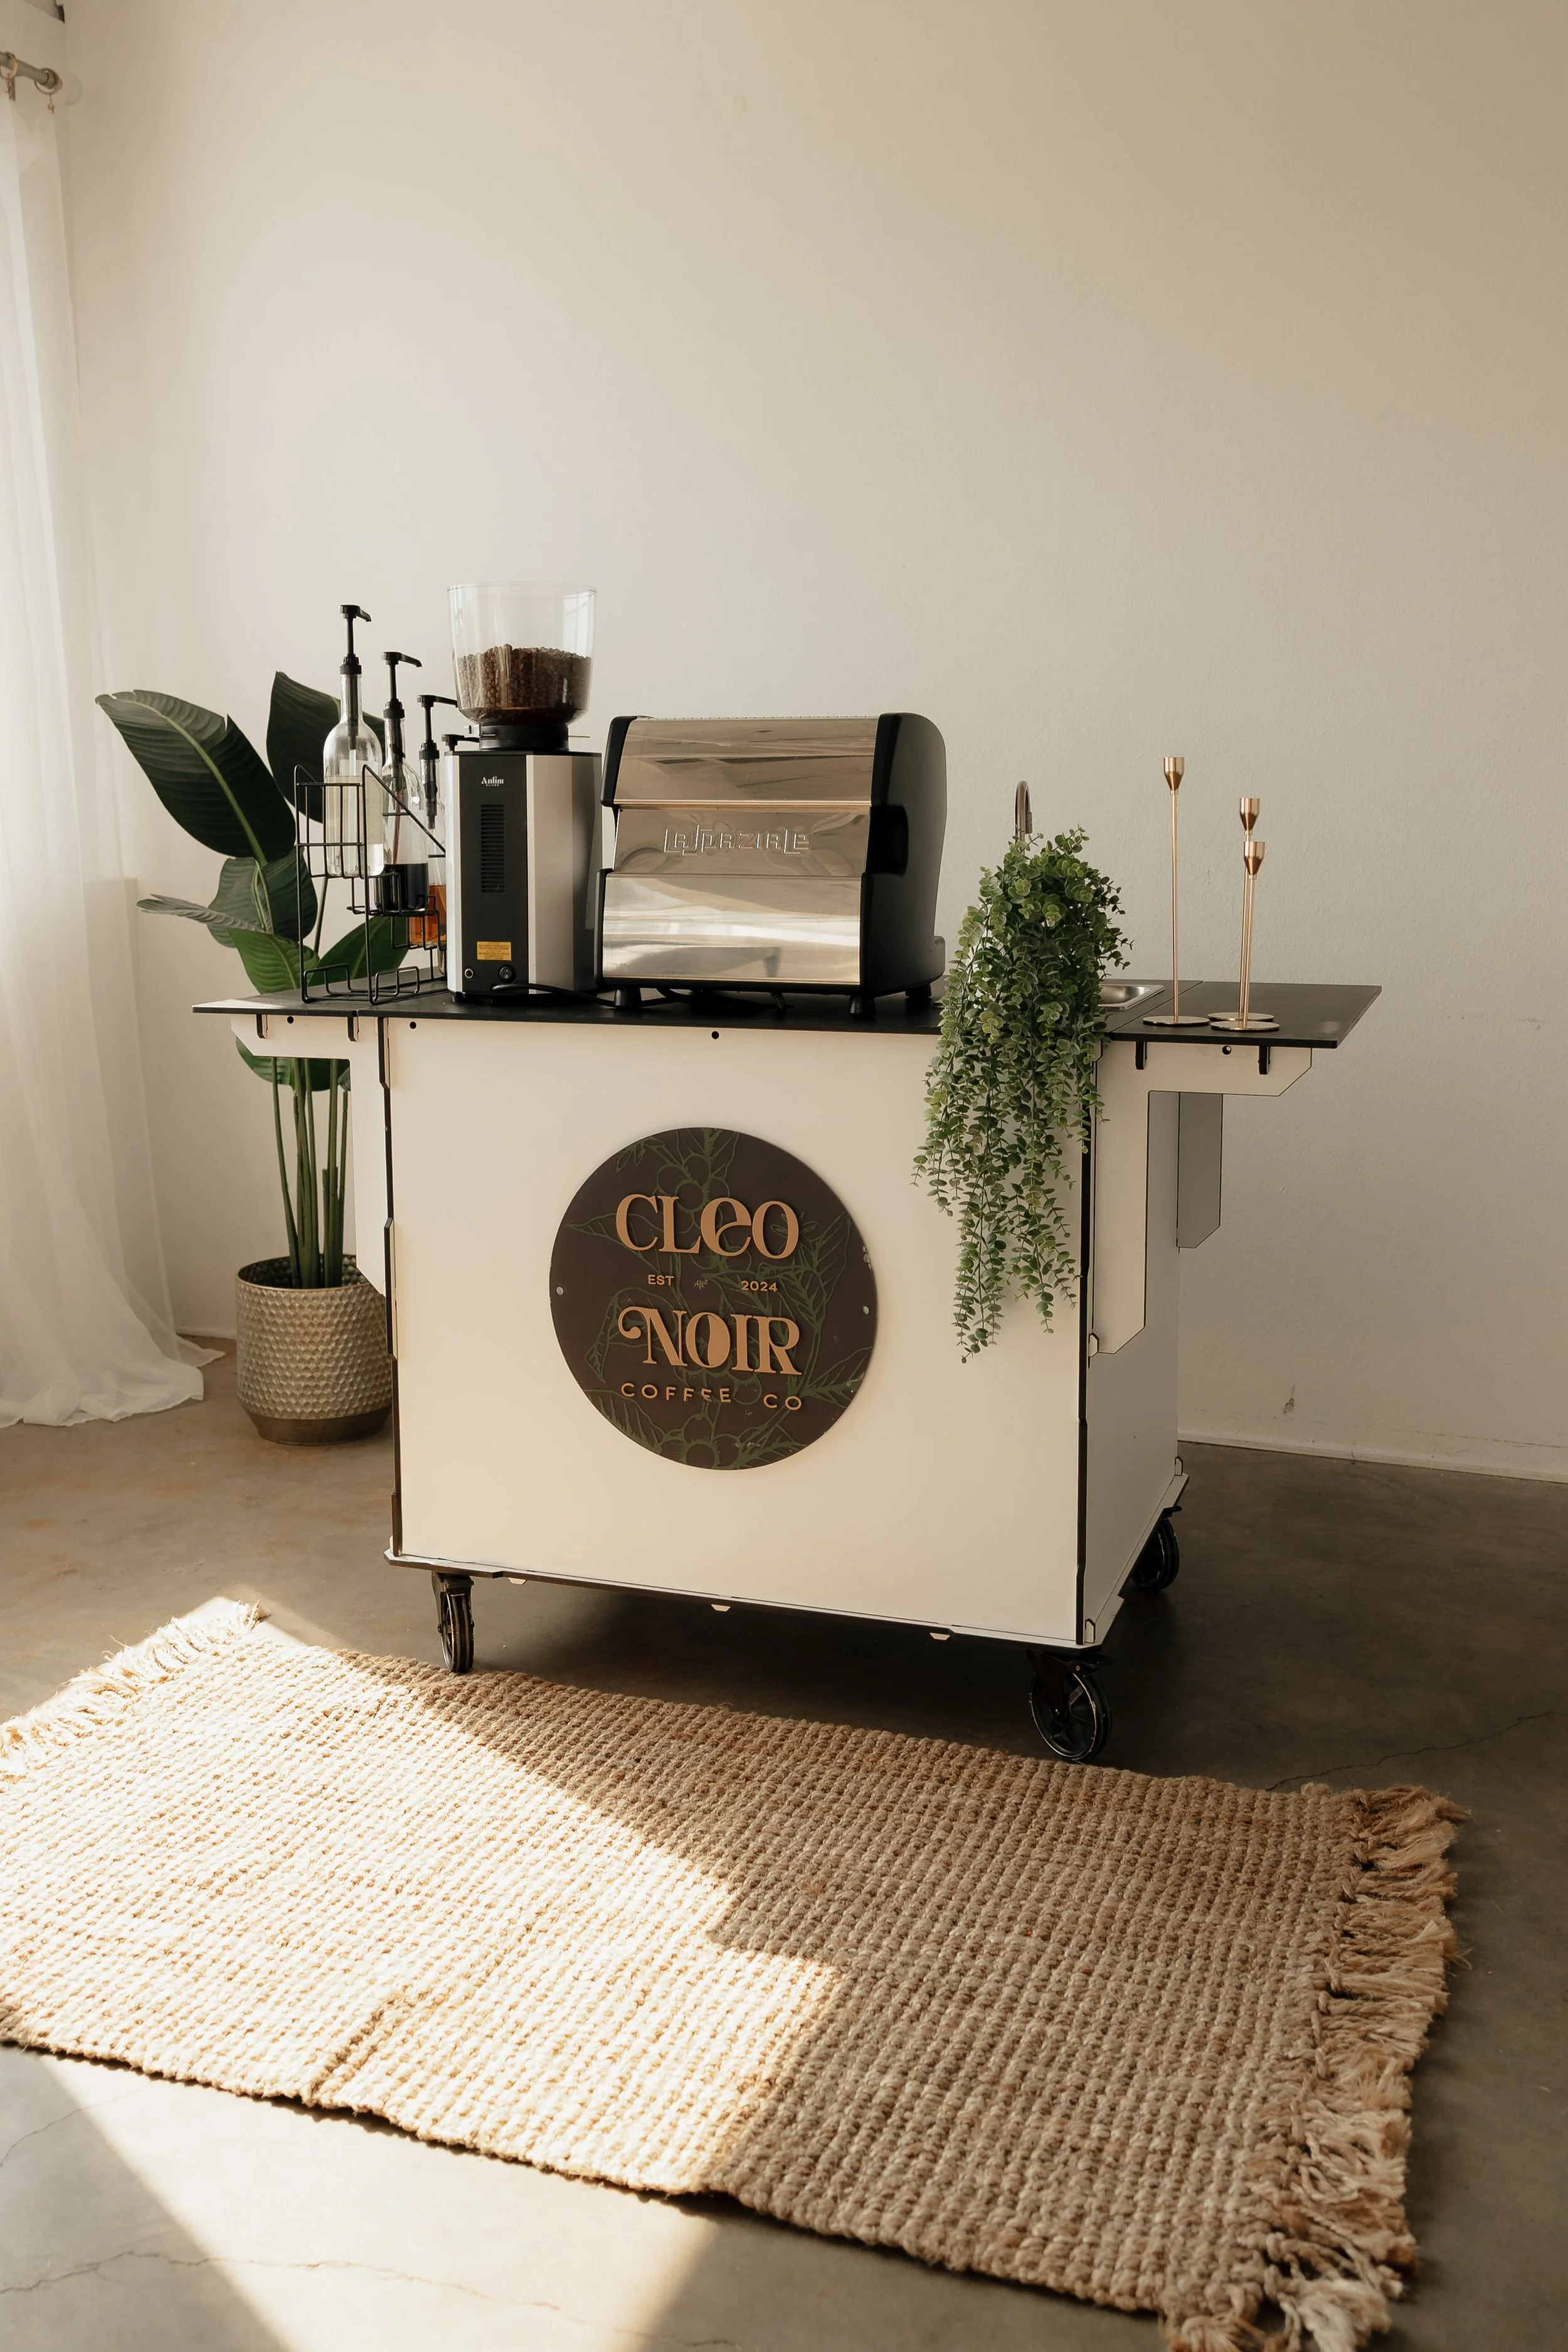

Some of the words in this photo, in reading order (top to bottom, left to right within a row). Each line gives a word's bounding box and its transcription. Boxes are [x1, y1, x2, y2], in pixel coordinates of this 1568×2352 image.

[649, 1275, 674, 1285] EST
[741, 1280, 777, 1292] 2024
[618, 1307, 802, 1375] NOIR
[622, 1383, 731, 1402] COFFEE
[764, 1394, 801, 1410] CO
